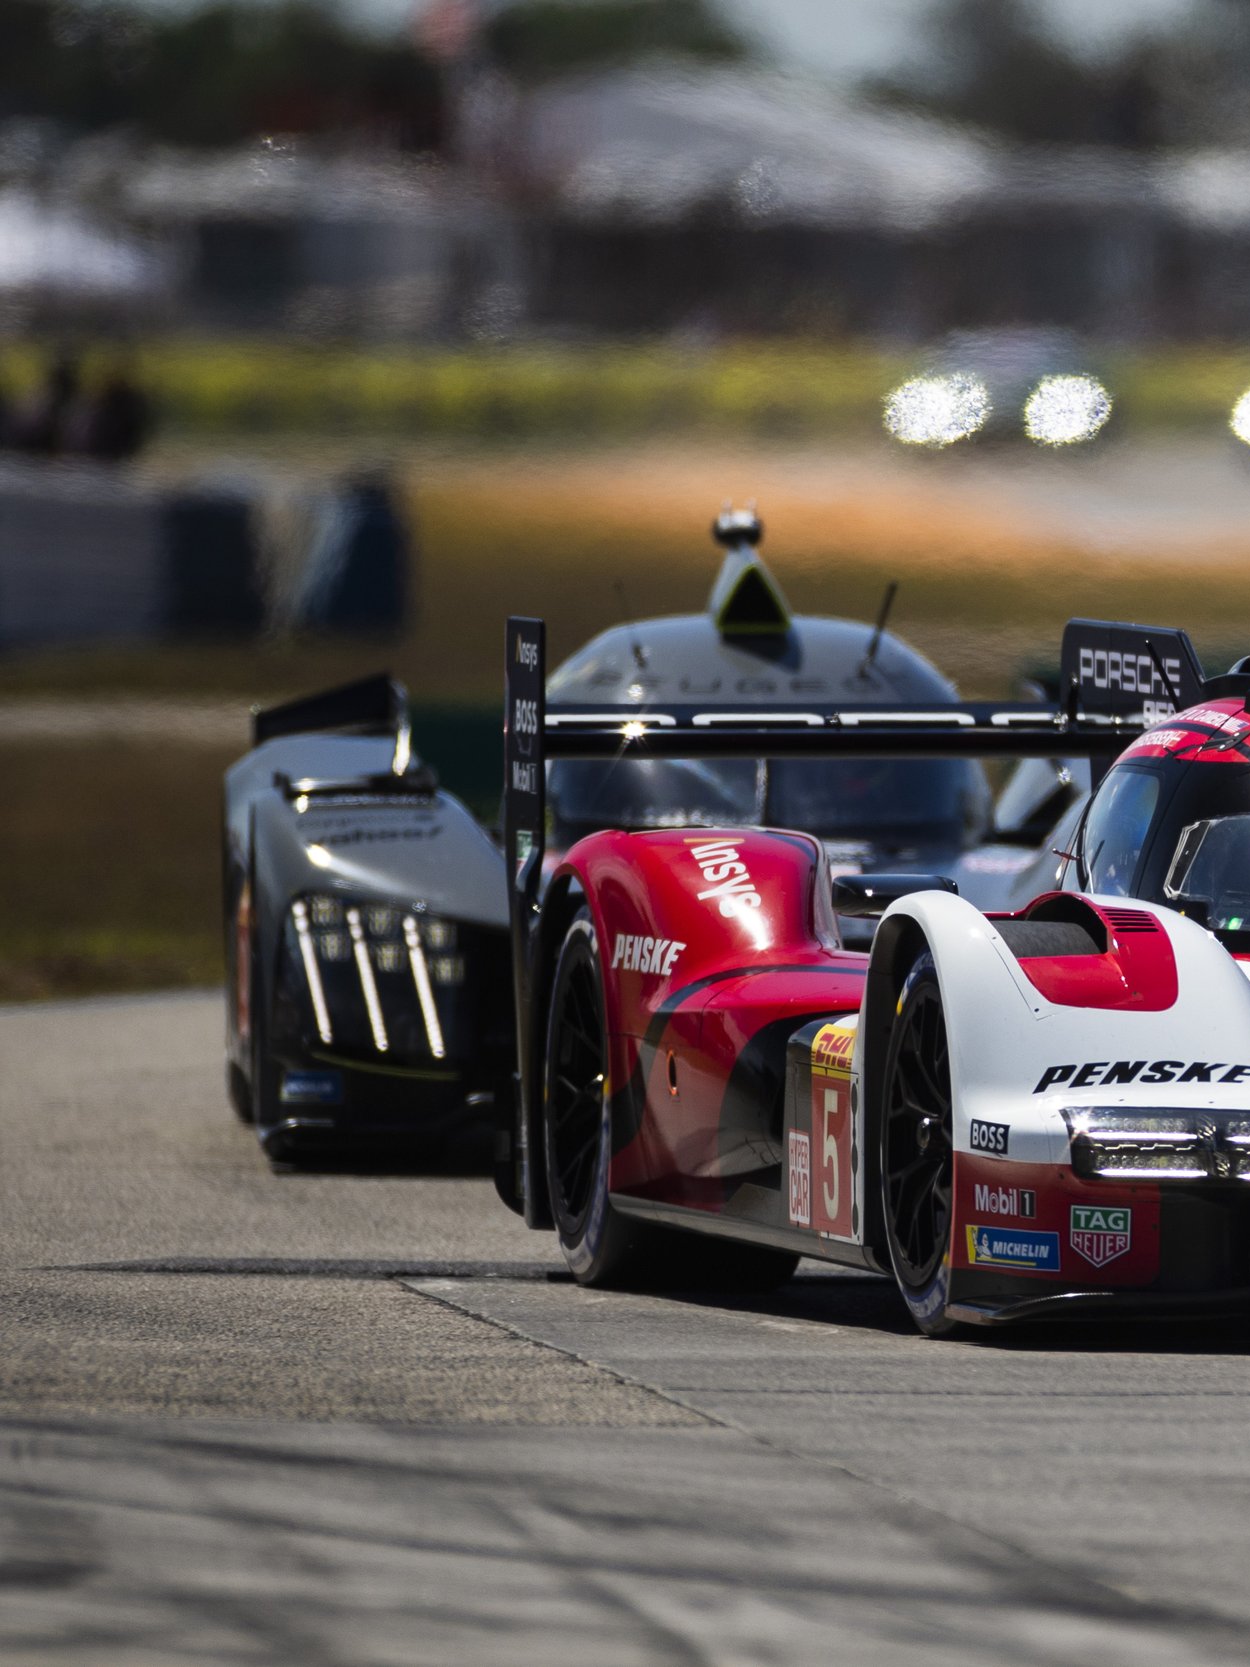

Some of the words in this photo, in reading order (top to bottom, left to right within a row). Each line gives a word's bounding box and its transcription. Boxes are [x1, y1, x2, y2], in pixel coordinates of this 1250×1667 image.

[515, 632, 538, 672] Ansys
[1079, 648, 1180, 697] PORSCHE
[515, 699, 538, 735] BOSS
[683, 838, 762, 918] Ansys
[611, 933, 688, 976] PENSKE
[814, 1032, 851, 1069] DHL
[790, 1137, 809, 1170] HYPER
[823, 1089, 840, 1220] 5
[972, 1123, 1006, 1151] BOSS
[790, 1173, 809, 1218] CAR
[974, 1183, 1017, 1216] Mobil
[1075, 1210, 1124, 1230] TAG
[992, 1240, 1050, 1259] MICHELIN
[1073, 1233, 1126, 1262] HEUER
